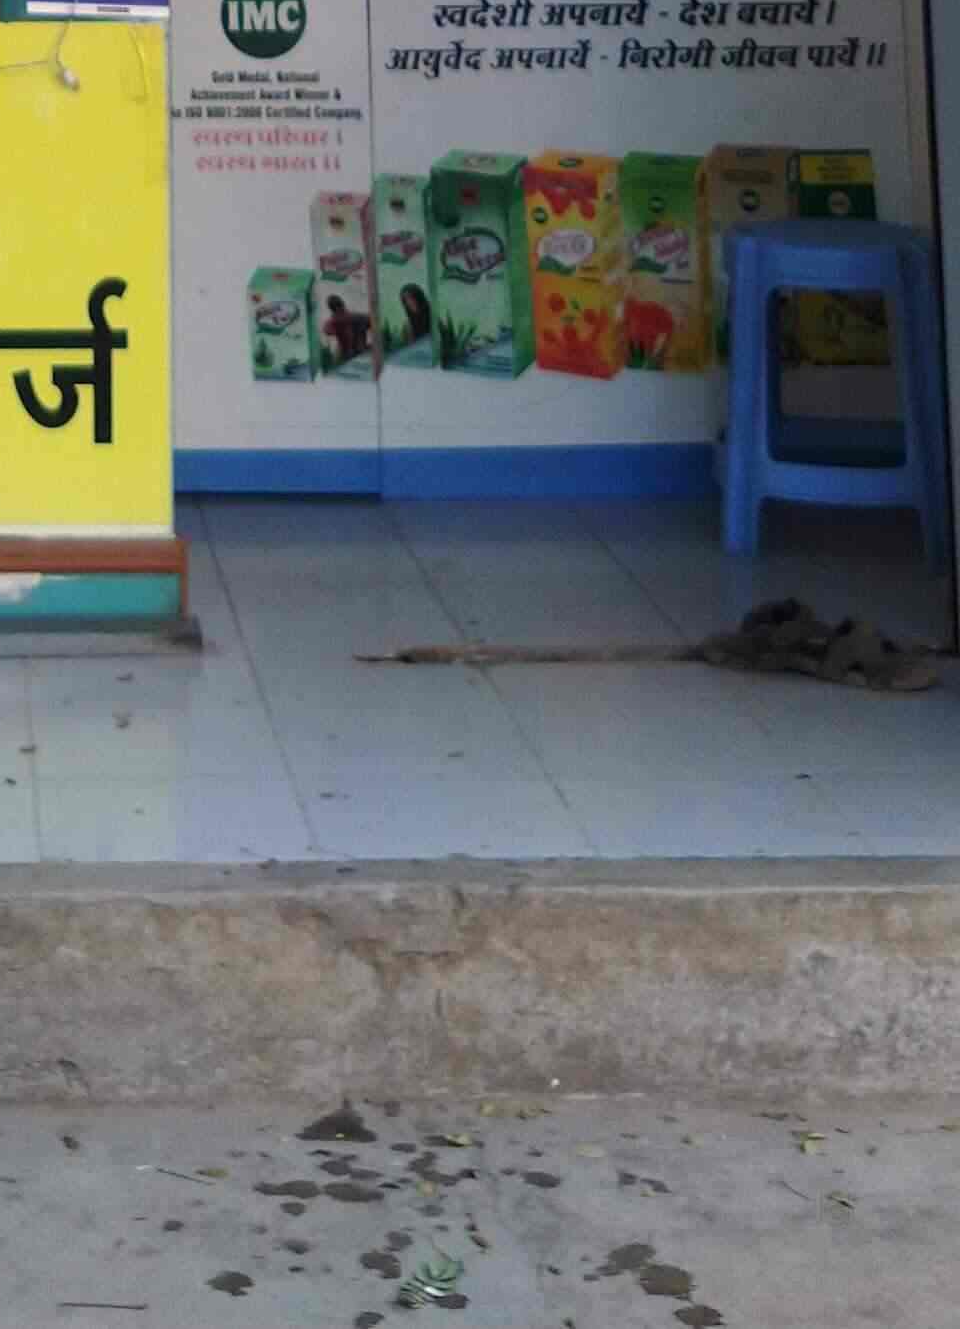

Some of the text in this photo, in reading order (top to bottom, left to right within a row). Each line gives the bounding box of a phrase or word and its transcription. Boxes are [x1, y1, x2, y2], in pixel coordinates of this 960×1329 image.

[226, 0, 301, 33] IMC
[384, 38, 482, 79] आयुर्वेद
[616, 37, 714, 70] निरोगी
[722, 37, 798, 69] जीवन
